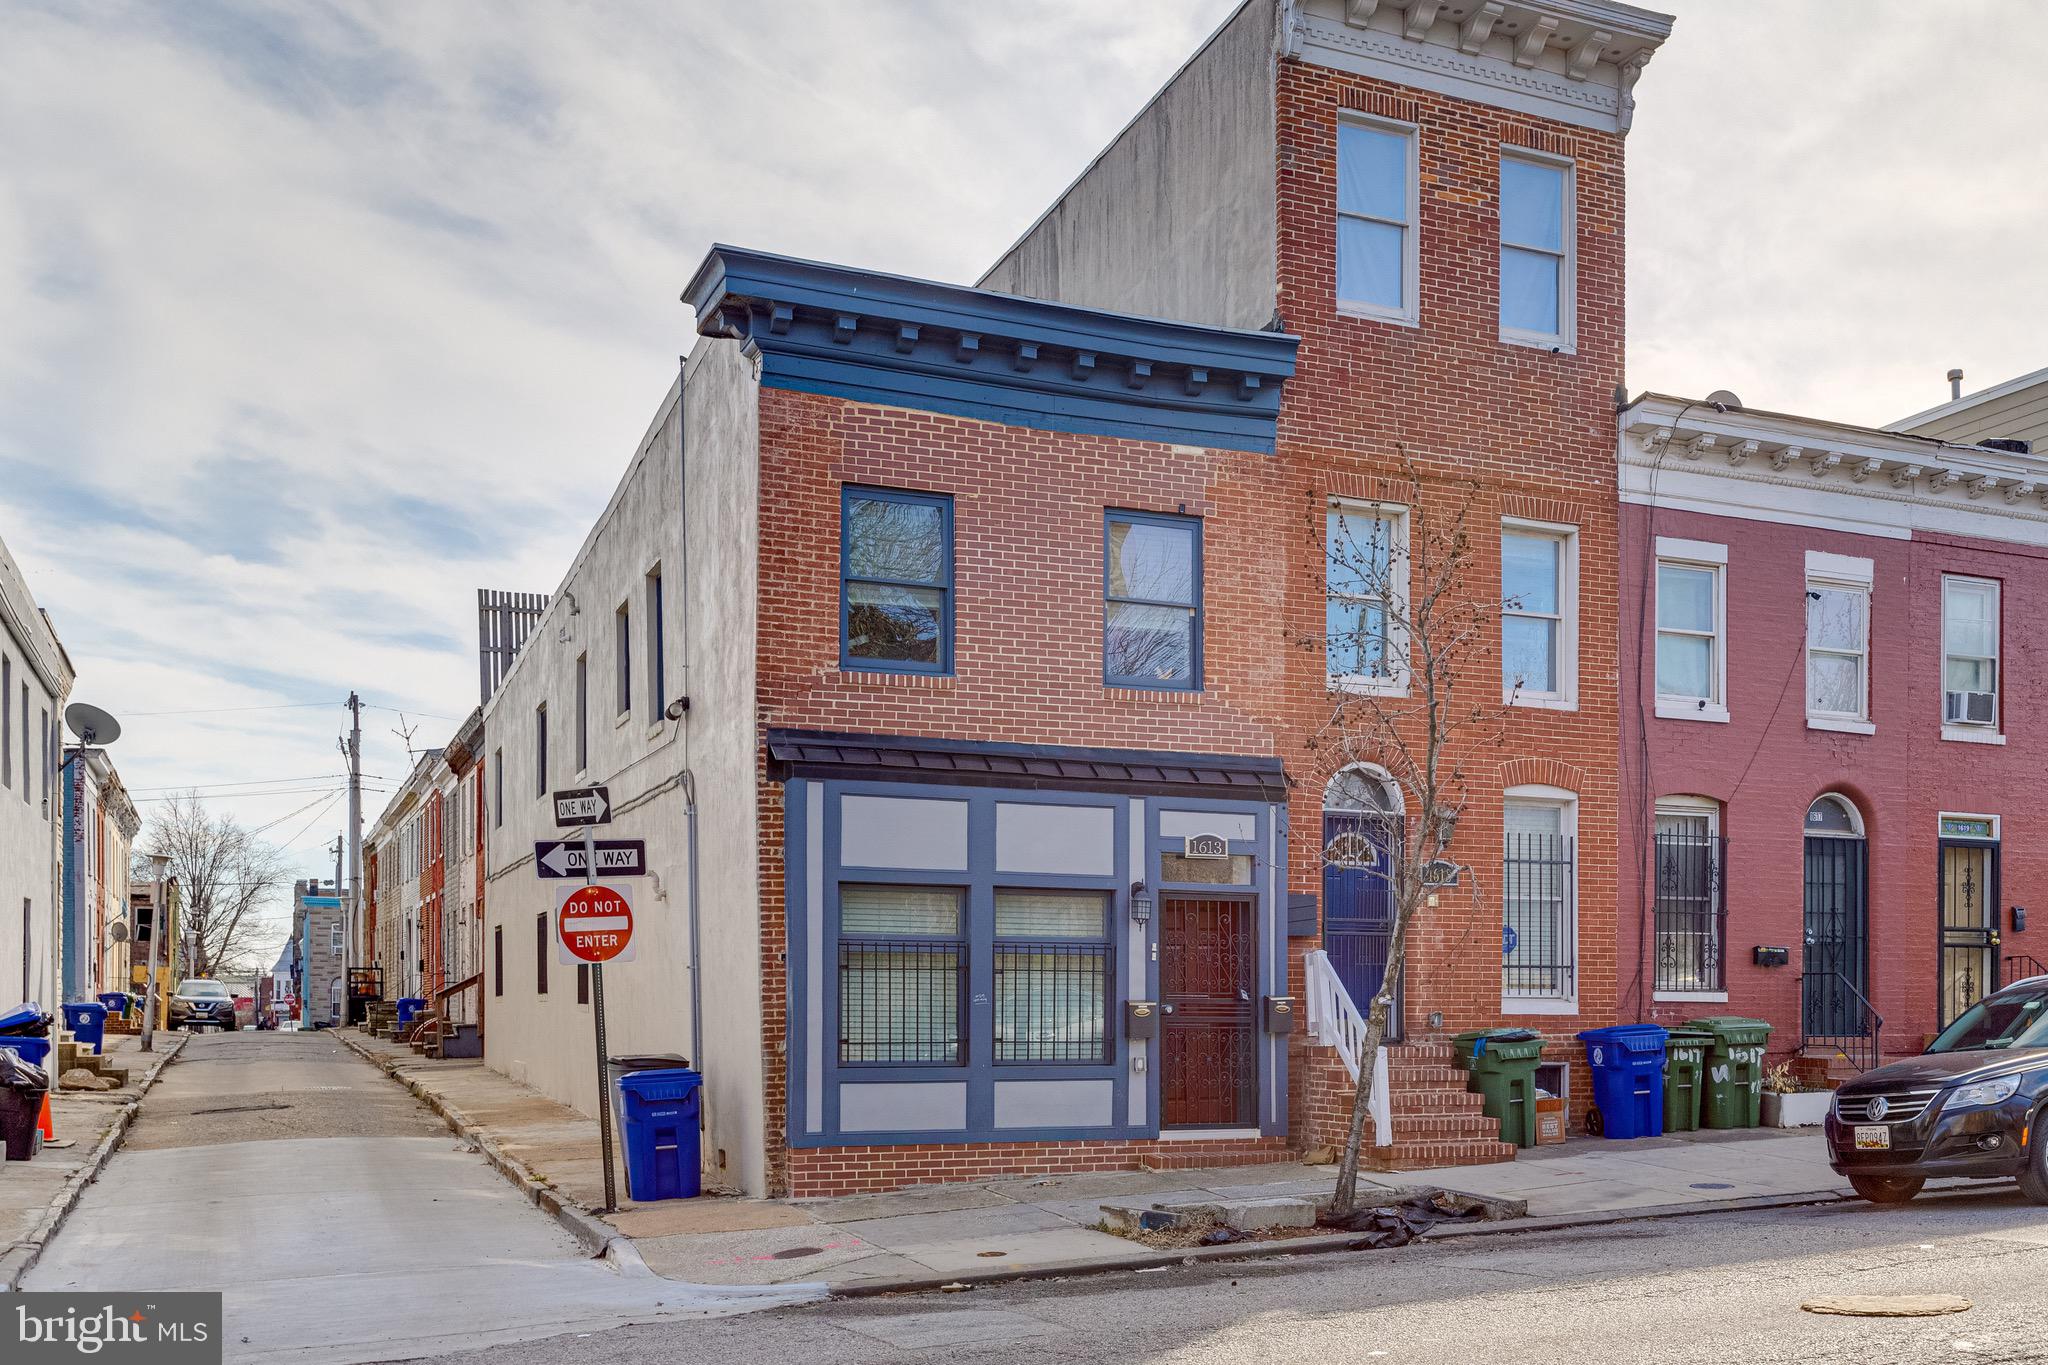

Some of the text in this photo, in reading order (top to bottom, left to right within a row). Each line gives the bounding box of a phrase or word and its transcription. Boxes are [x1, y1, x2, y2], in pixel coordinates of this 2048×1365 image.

[559, 799, 597, 816] ONE WAY
[1192, 840, 1222, 854] 1613
[567, 851, 633, 867] ON WAY
[569, 900, 621, 914] DO NOT
[576, 934, 618, 948] ENTER
